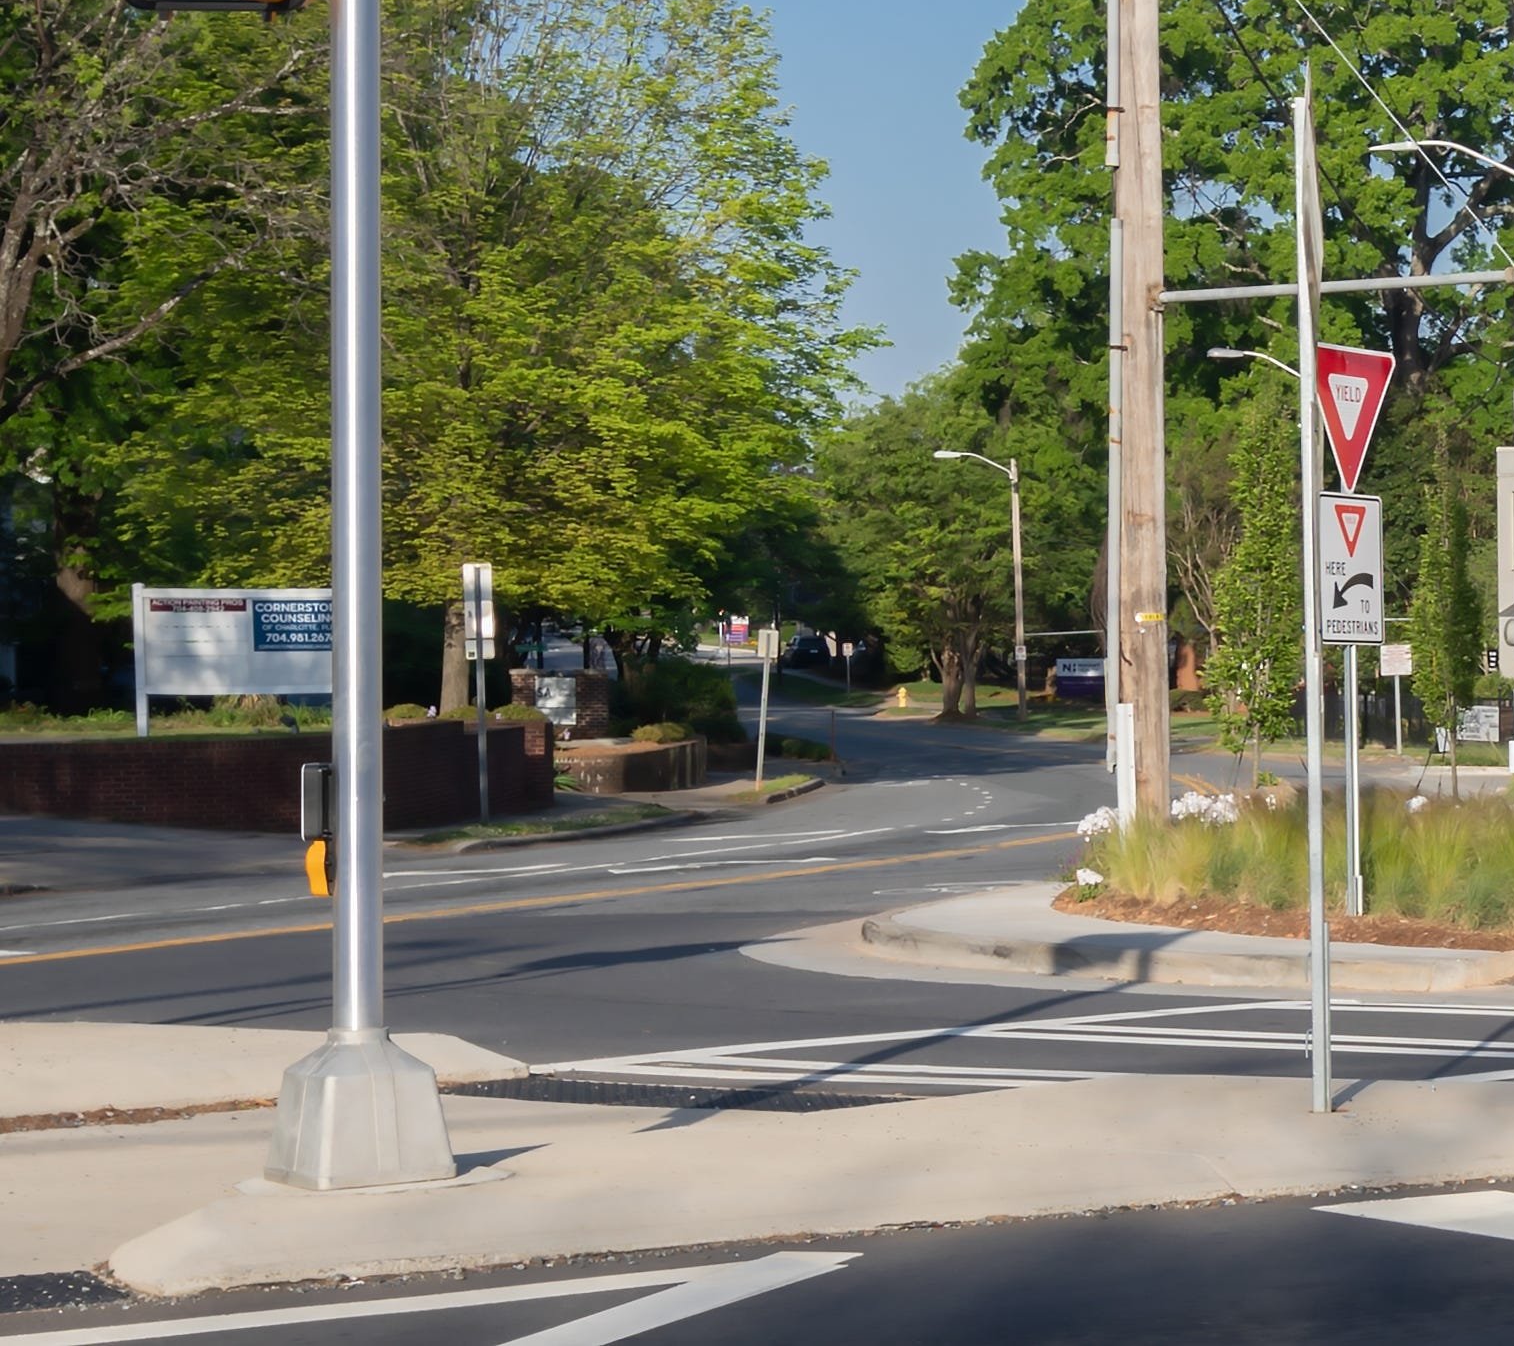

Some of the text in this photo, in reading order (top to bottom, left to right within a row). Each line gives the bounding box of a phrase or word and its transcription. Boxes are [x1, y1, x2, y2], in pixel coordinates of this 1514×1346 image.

[1335, 384, 1361, 403] YIELD
[1325, 561, 1346, 576] HERE
[1360, 599, 1370, 614] TO
[1326, 619, 1379, 636] PEDESTRIANS
